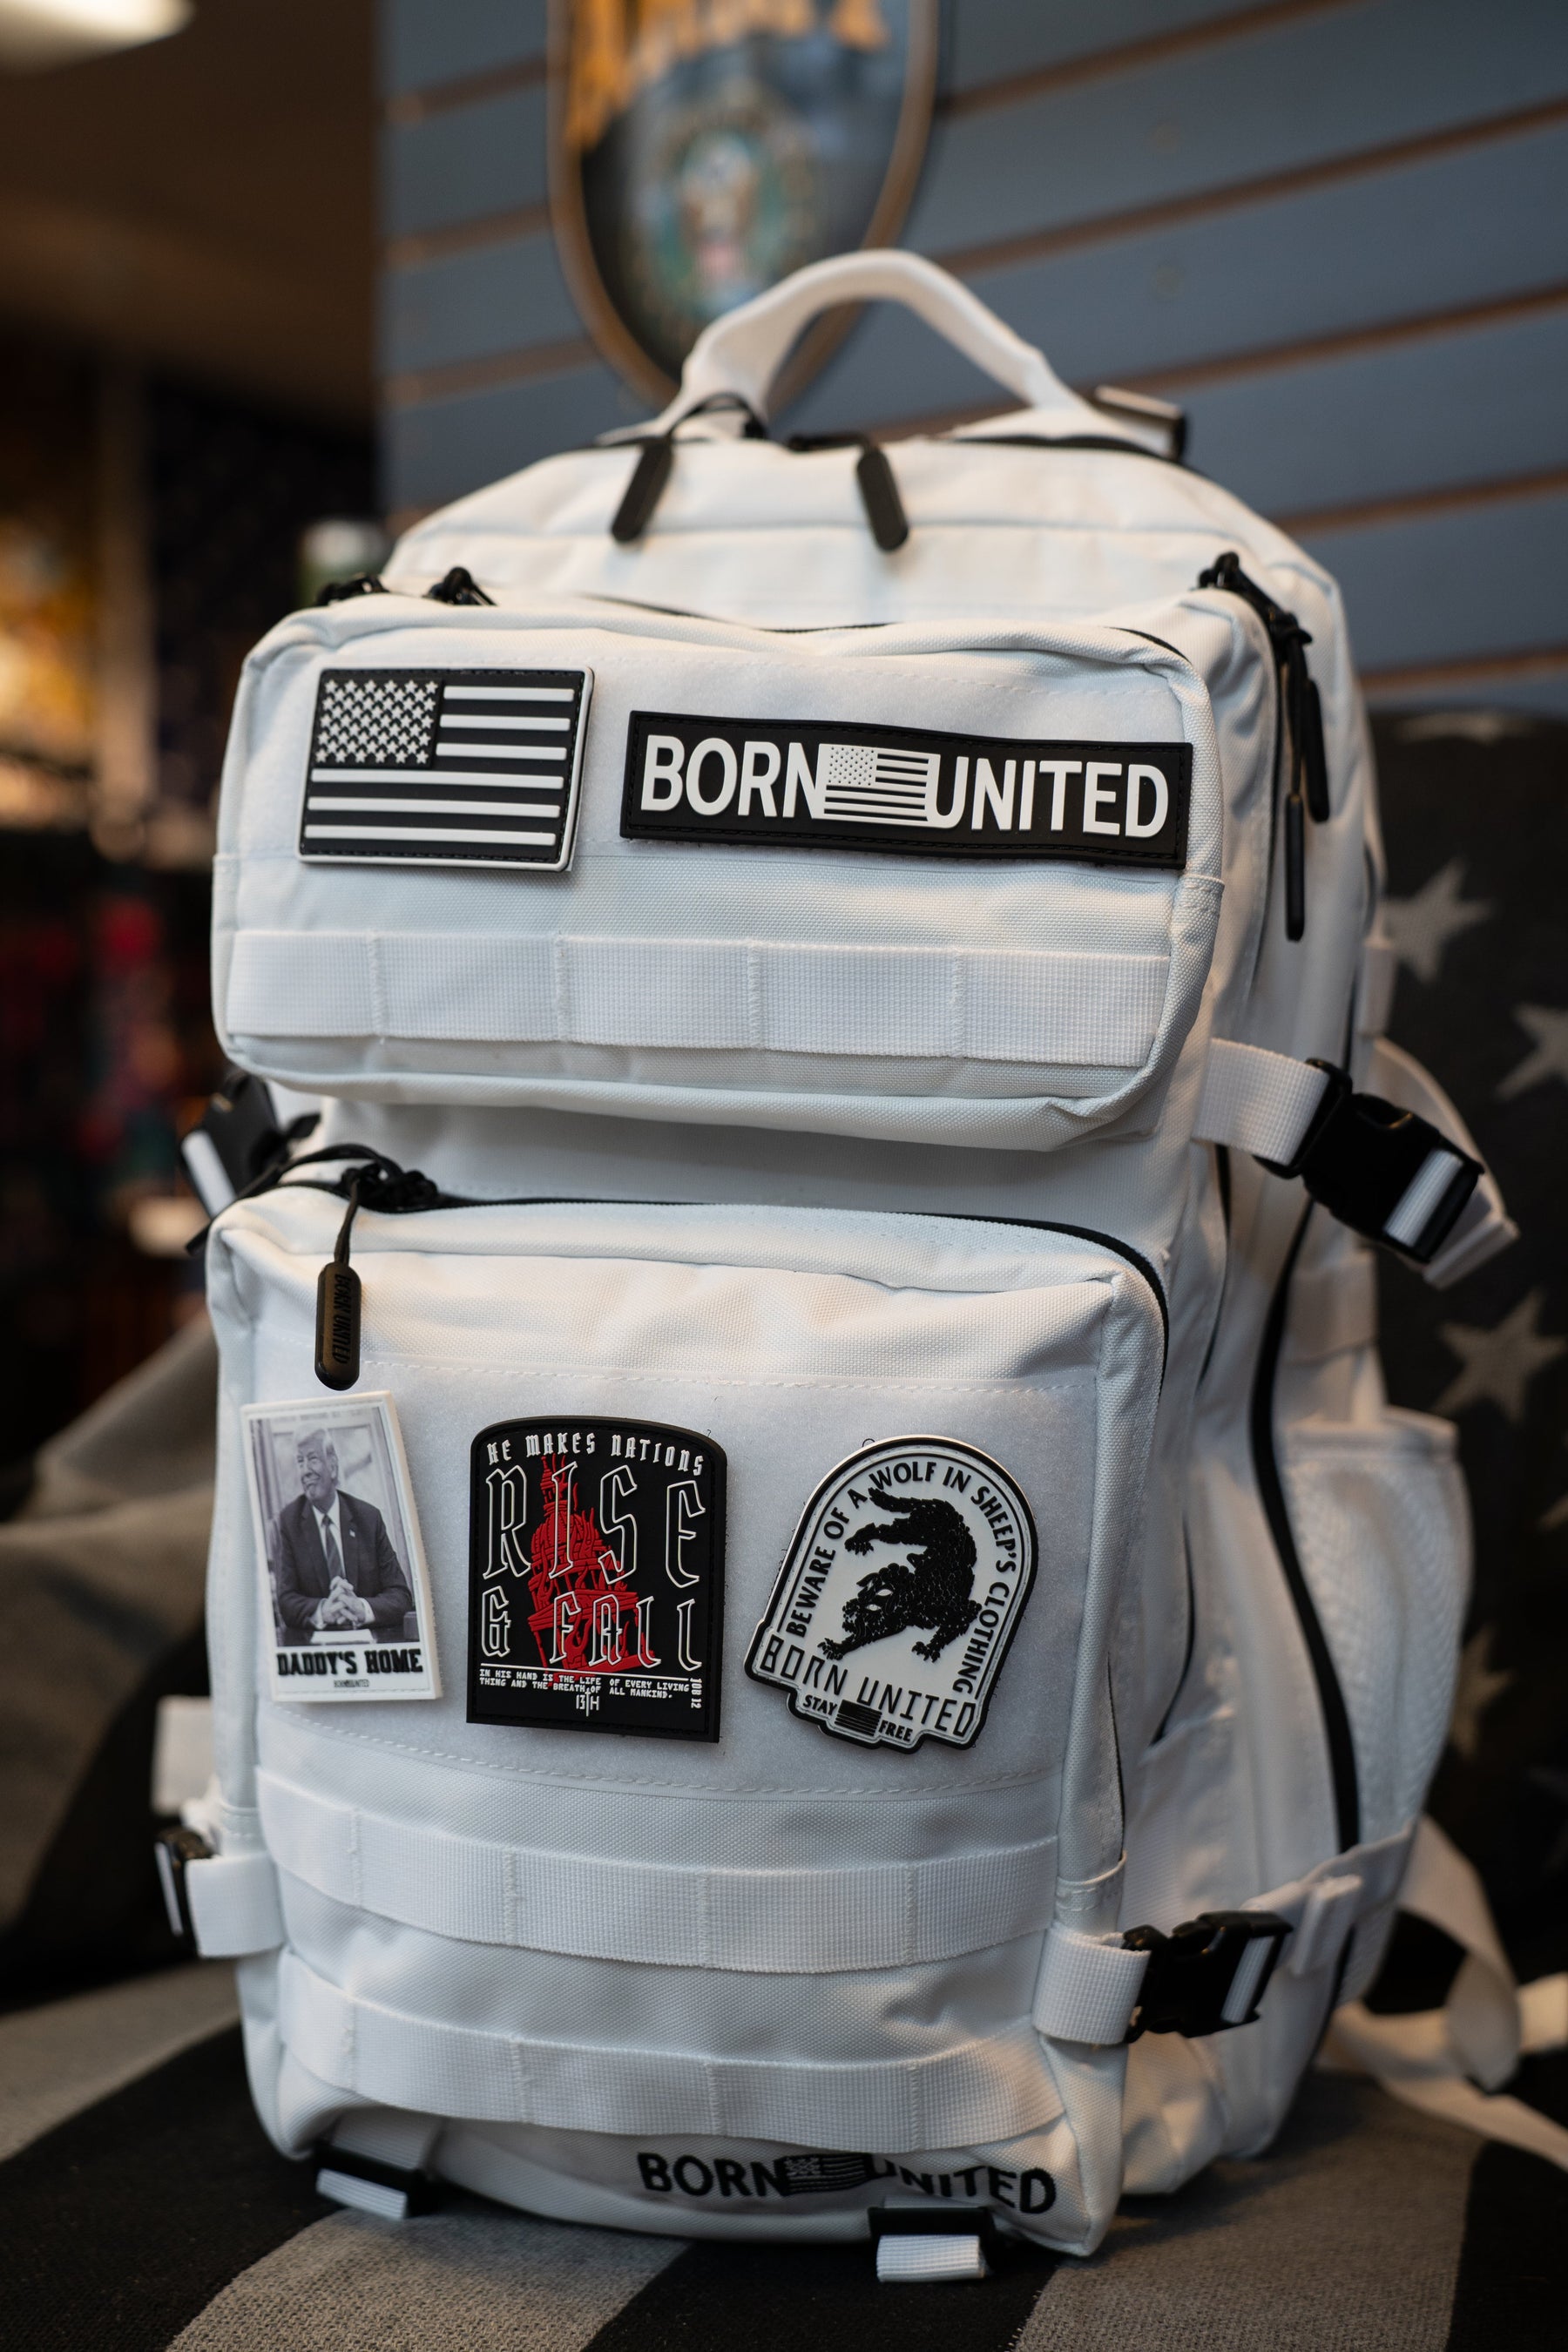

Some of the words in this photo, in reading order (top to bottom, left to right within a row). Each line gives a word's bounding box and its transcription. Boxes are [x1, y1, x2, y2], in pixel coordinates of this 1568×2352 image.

[640, 733, 822, 820] BORN
[926, 754, 1169, 839] UNITED
[486, 1439, 512, 1465] HE
[525, 1432, 595, 1457] MAKES
[611, 1434, 704, 1477] NATIONS
[868, 1461, 936, 1490] WOLF
[847, 1489, 868, 1509] A
[943, 1466, 972, 1493] IN
[483, 1461, 706, 1588] RISE
[823, 1506, 850, 1540] OF
[970, 1485, 1017, 1573] SHEEP'S
[786, 1545, 836, 1638] BEWARE
[549, 1591, 702, 1671] FALL
[952, 1582, 1010, 1693] CLOTHING
[276, 1651, 357, 1676] DADDY'S
[364, 1648, 423, 1674] HOME
[495, 1670, 511, 1679] HIS
[516, 1672, 537, 1680] HAND
[558, 1675, 575, 1684] THE
[580, 1676, 601, 1686] LIFE
[625, 1680, 652, 1689] EVERY
[657, 1681, 689, 1692] LIVING
[479, 1677, 506, 1686] THING
[511, 1680, 527, 1688] AND
[532, 1681, 548, 1690] THE
[553, 1683, 585, 1693] BREATH
[610, 1686, 625, 1695] ALL
[630, 1688, 672, 1699] MANKIND.
[690, 1678, 702, 1695] JOB
[760, 1633, 848, 1696] BORN
[857, 1676, 977, 1738] UNITED
[802, 1694, 838, 1715] STAY
[878, 1720, 914, 1742] FREE
[637, 2152, 785, 2197] BORN
[870, 2154, 1058, 2214] UNITED
